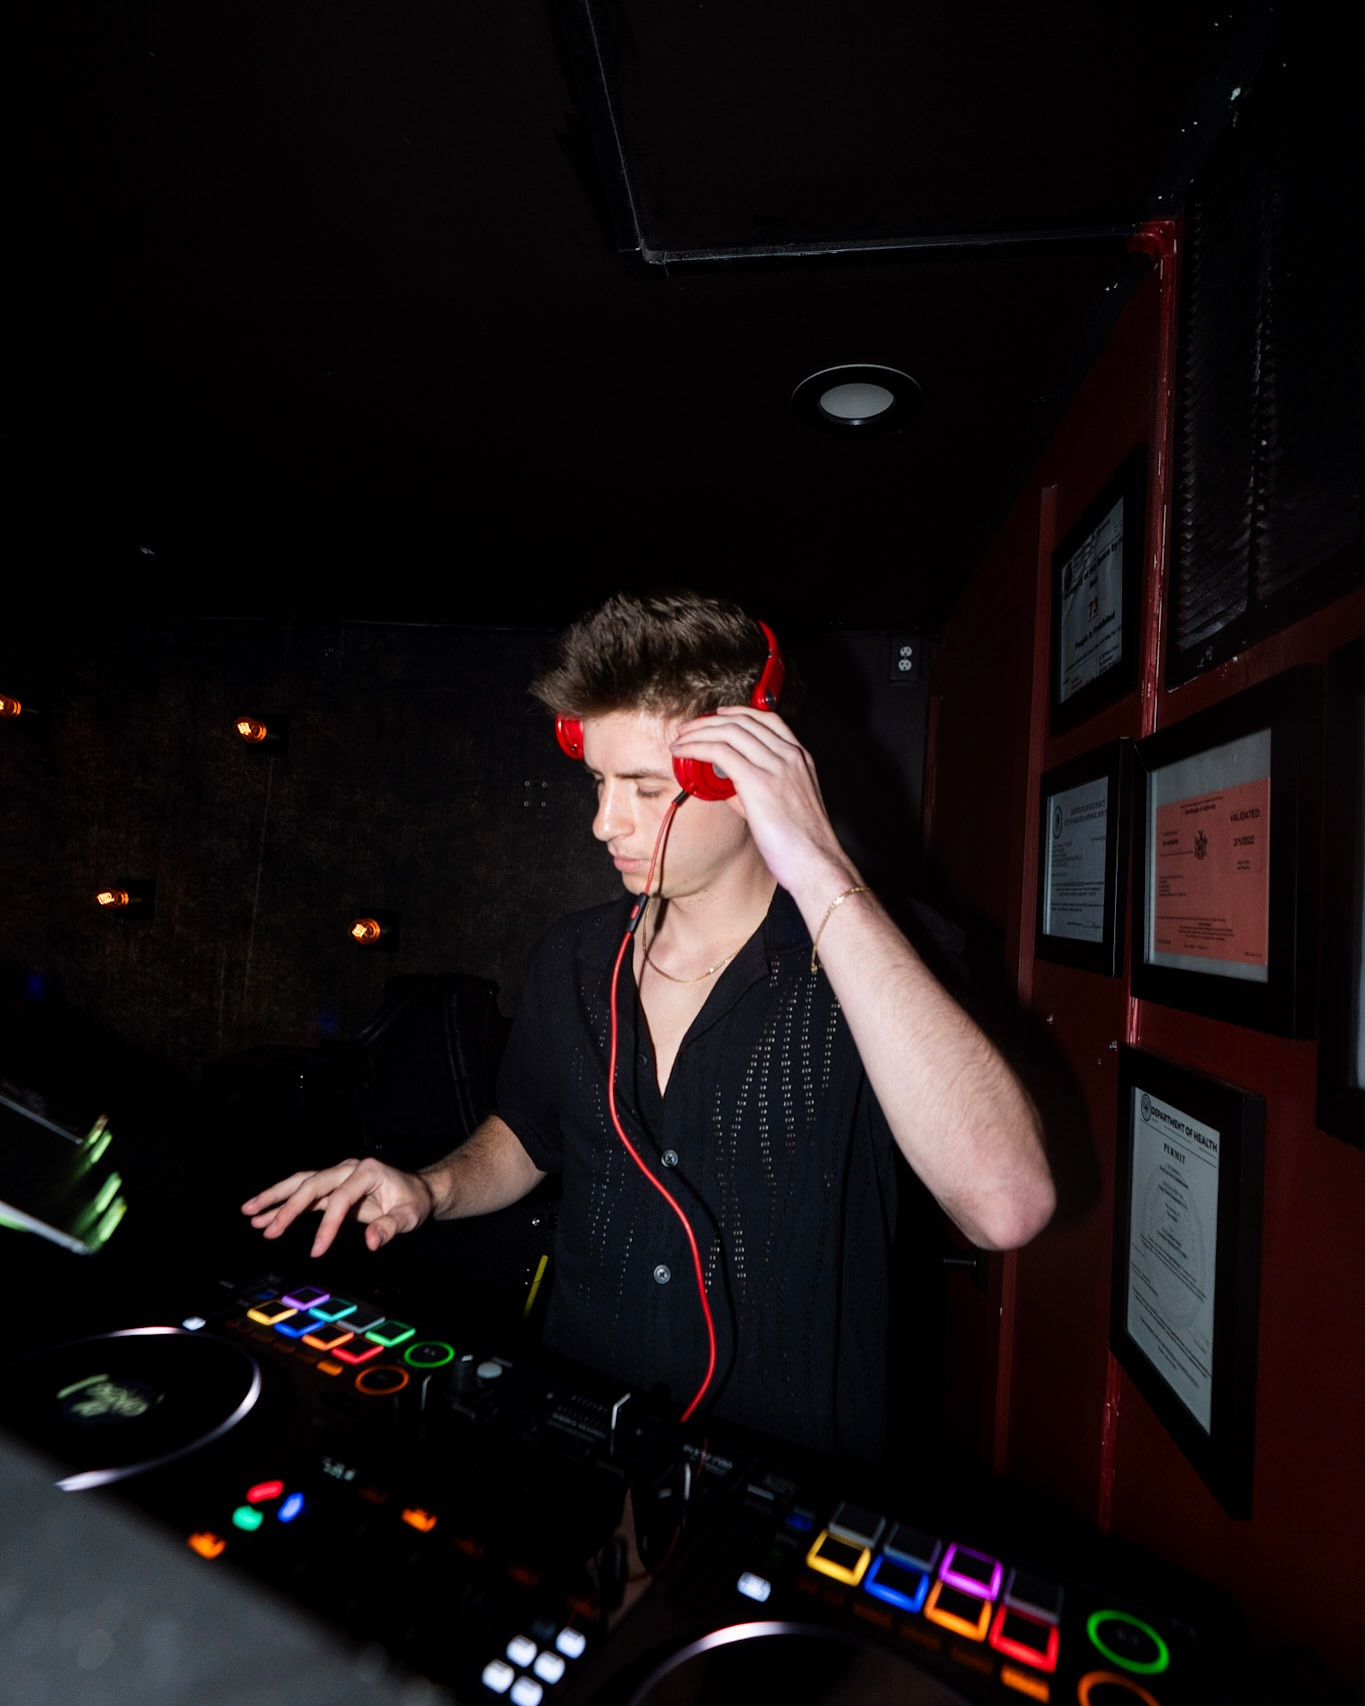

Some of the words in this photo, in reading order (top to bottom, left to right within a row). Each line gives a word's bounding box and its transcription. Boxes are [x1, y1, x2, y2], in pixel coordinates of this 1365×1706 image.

[1088, 597, 1098, 616] 73
[1229, 808, 1260, 822] VALIDATED
[1151, 1107, 1185, 1132] DEPARTMENT
[1185, 1127, 1193, 1137] OF
[1193, 1132, 1217, 1152] HEALTH
[1163, 1143, 1185, 1164] PERMIT
